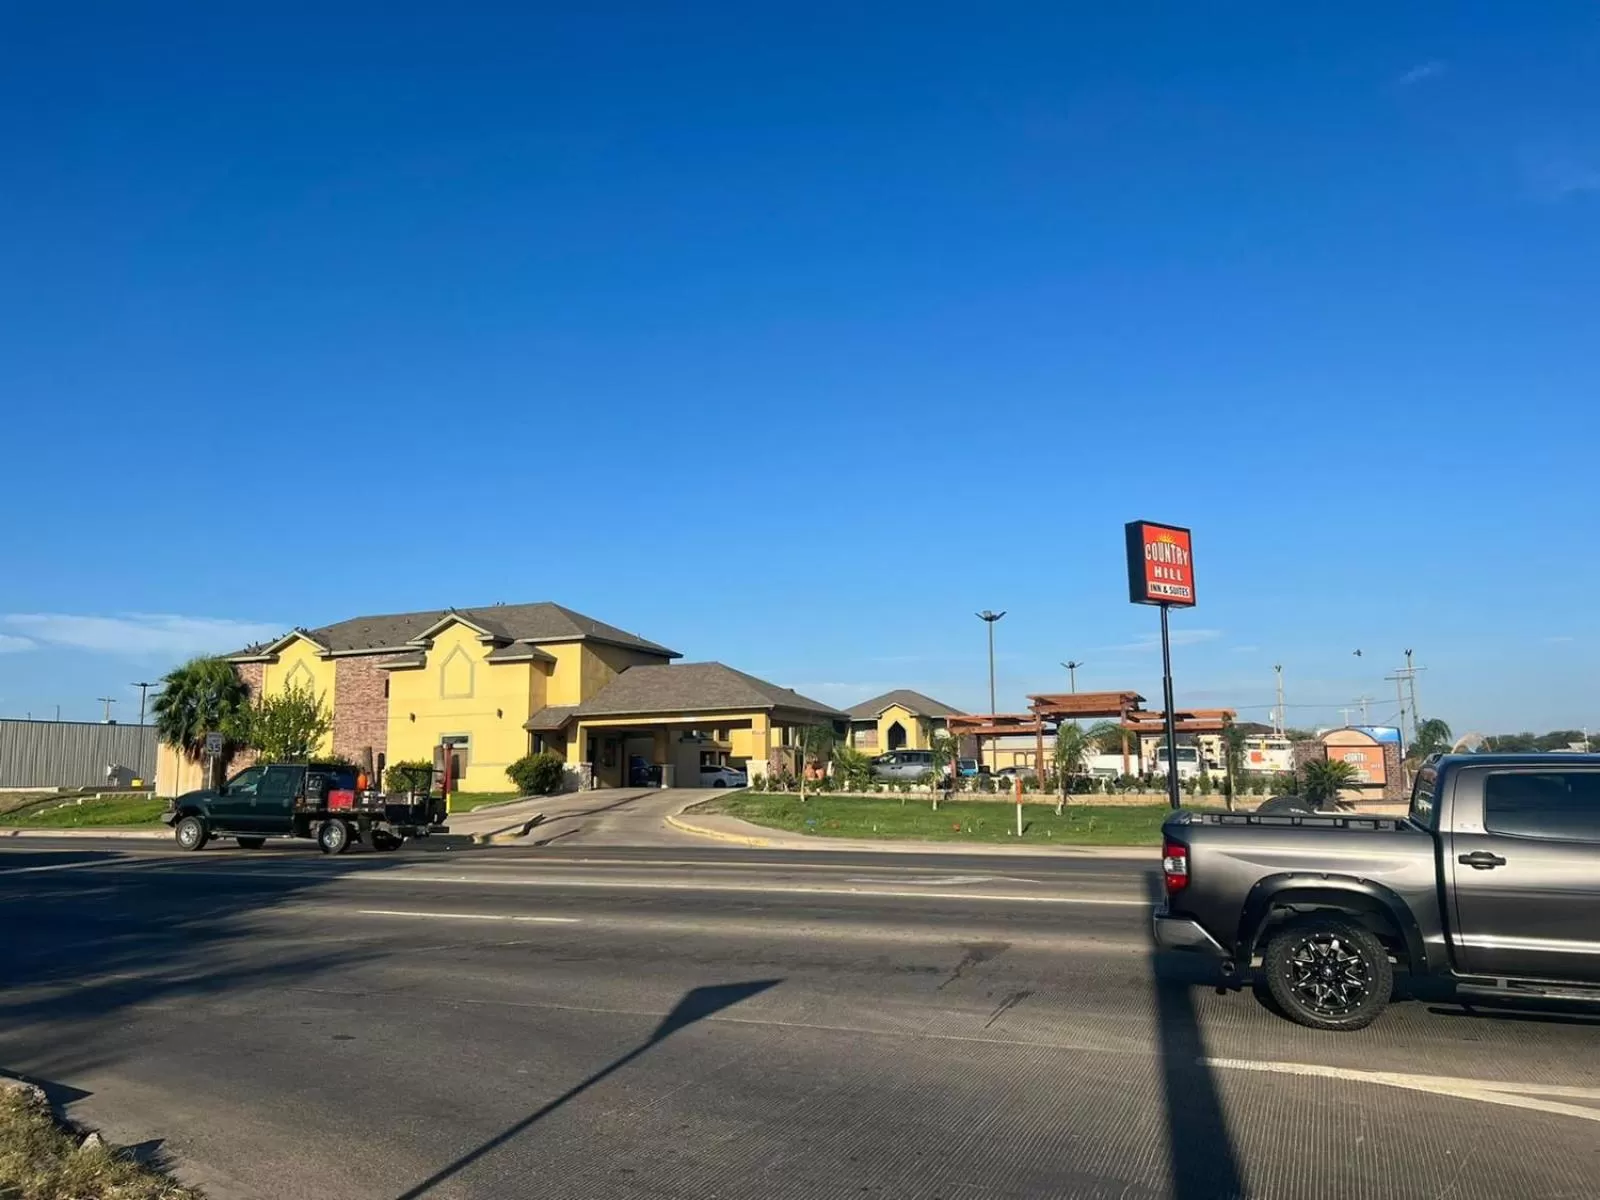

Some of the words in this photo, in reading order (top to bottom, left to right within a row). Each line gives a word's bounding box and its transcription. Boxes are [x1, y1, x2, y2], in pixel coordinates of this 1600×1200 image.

[1145, 542, 1189, 565] COUNTRY
[1154, 566, 1183, 581] HILL
[1150, 584, 1162, 592] INN
[1163, 585, 1168, 594] &
[1169, 586, 1189, 597] SUITES
